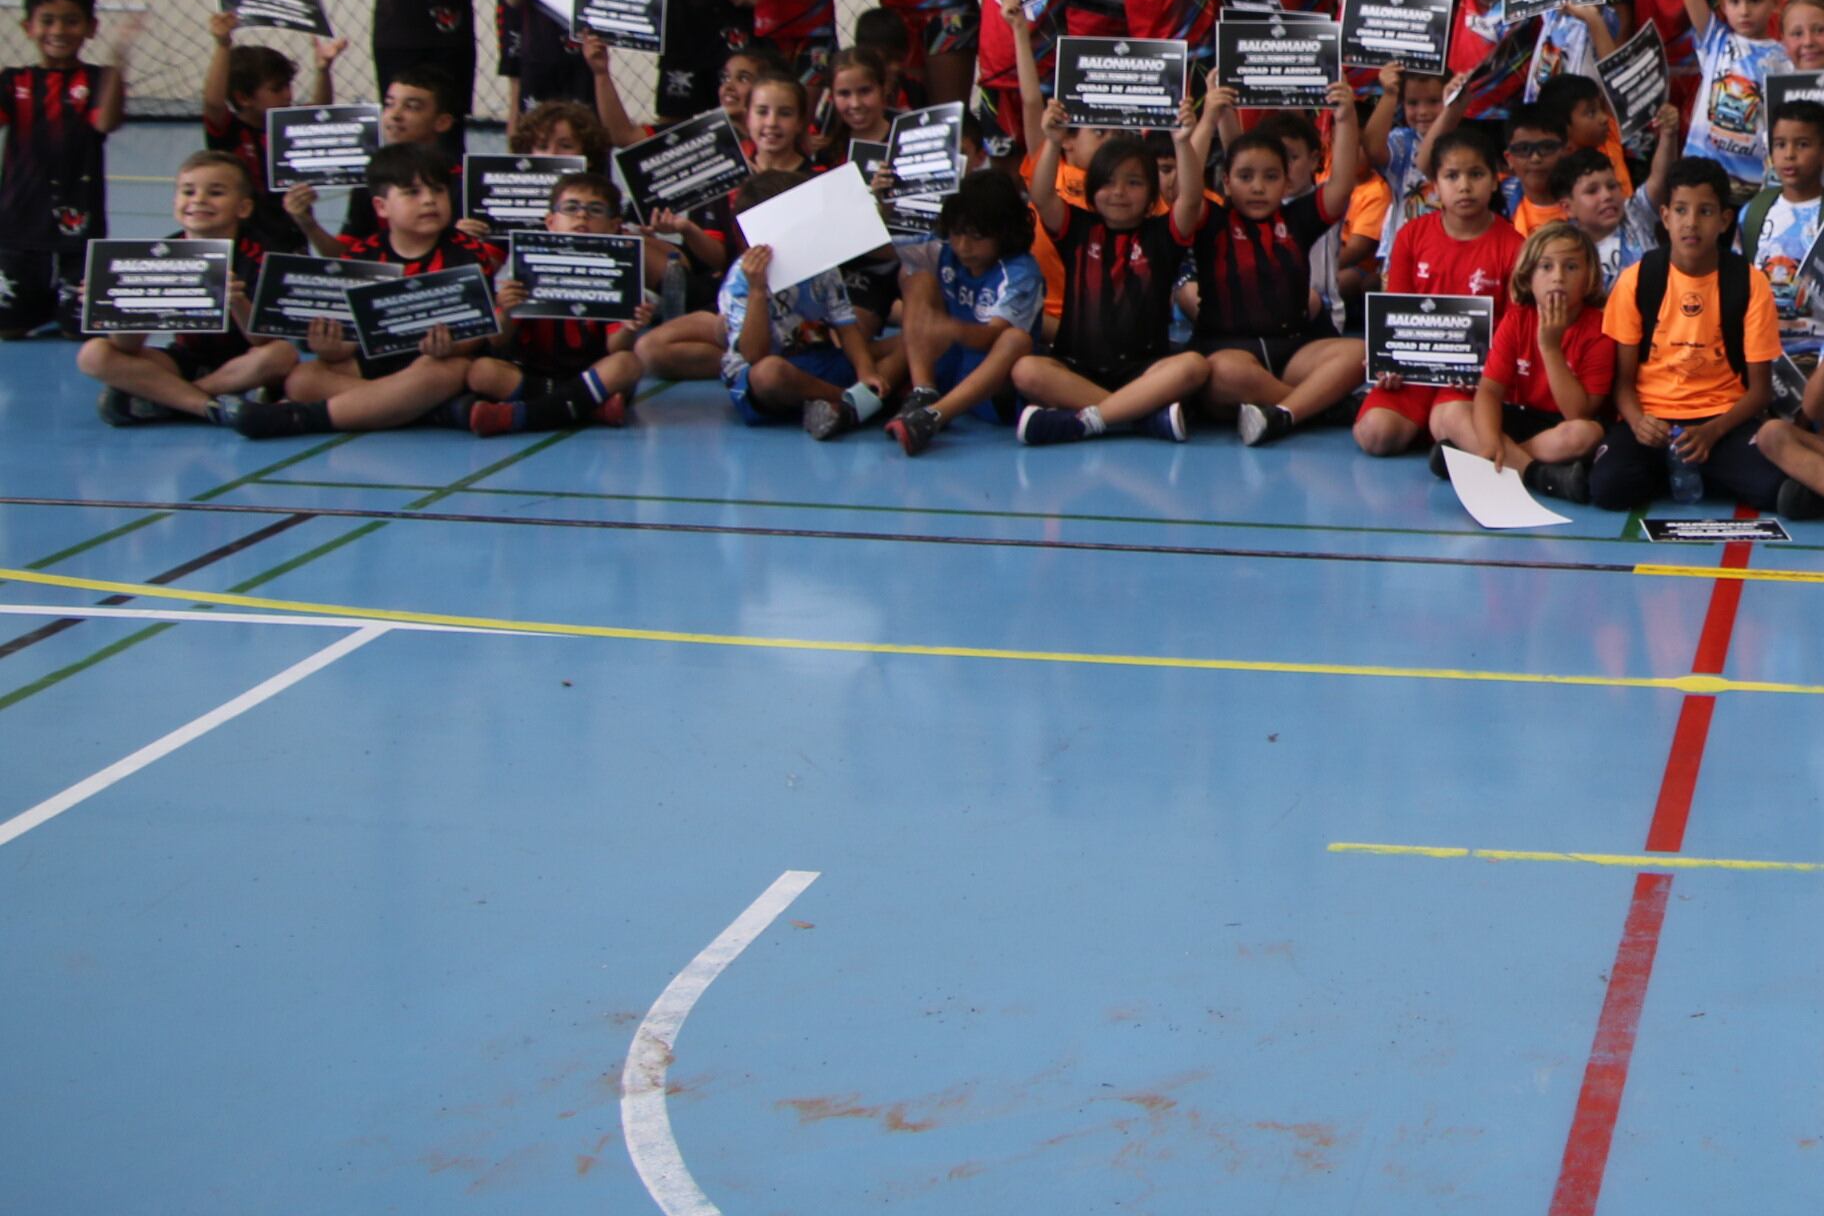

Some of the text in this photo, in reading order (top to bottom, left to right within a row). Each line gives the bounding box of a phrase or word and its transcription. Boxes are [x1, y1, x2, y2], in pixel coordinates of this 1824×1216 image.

[1359, 4, 1433, 21] BALONMANO
[1238, 39, 1320, 52] BALONMANO
[1078, 55, 1165, 71] BALONMANO
[1076, 84, 1164, 94] CIUDAD DE ARRECIFE
[110, 258, 208, 272] BALONMANO
[533, 286, 621, 302] BALONMANO
[1386, 313, 1471, 328] BALONMANO
[1385, 341, 1471, 352] CIUDAD DE ARRECIFE
